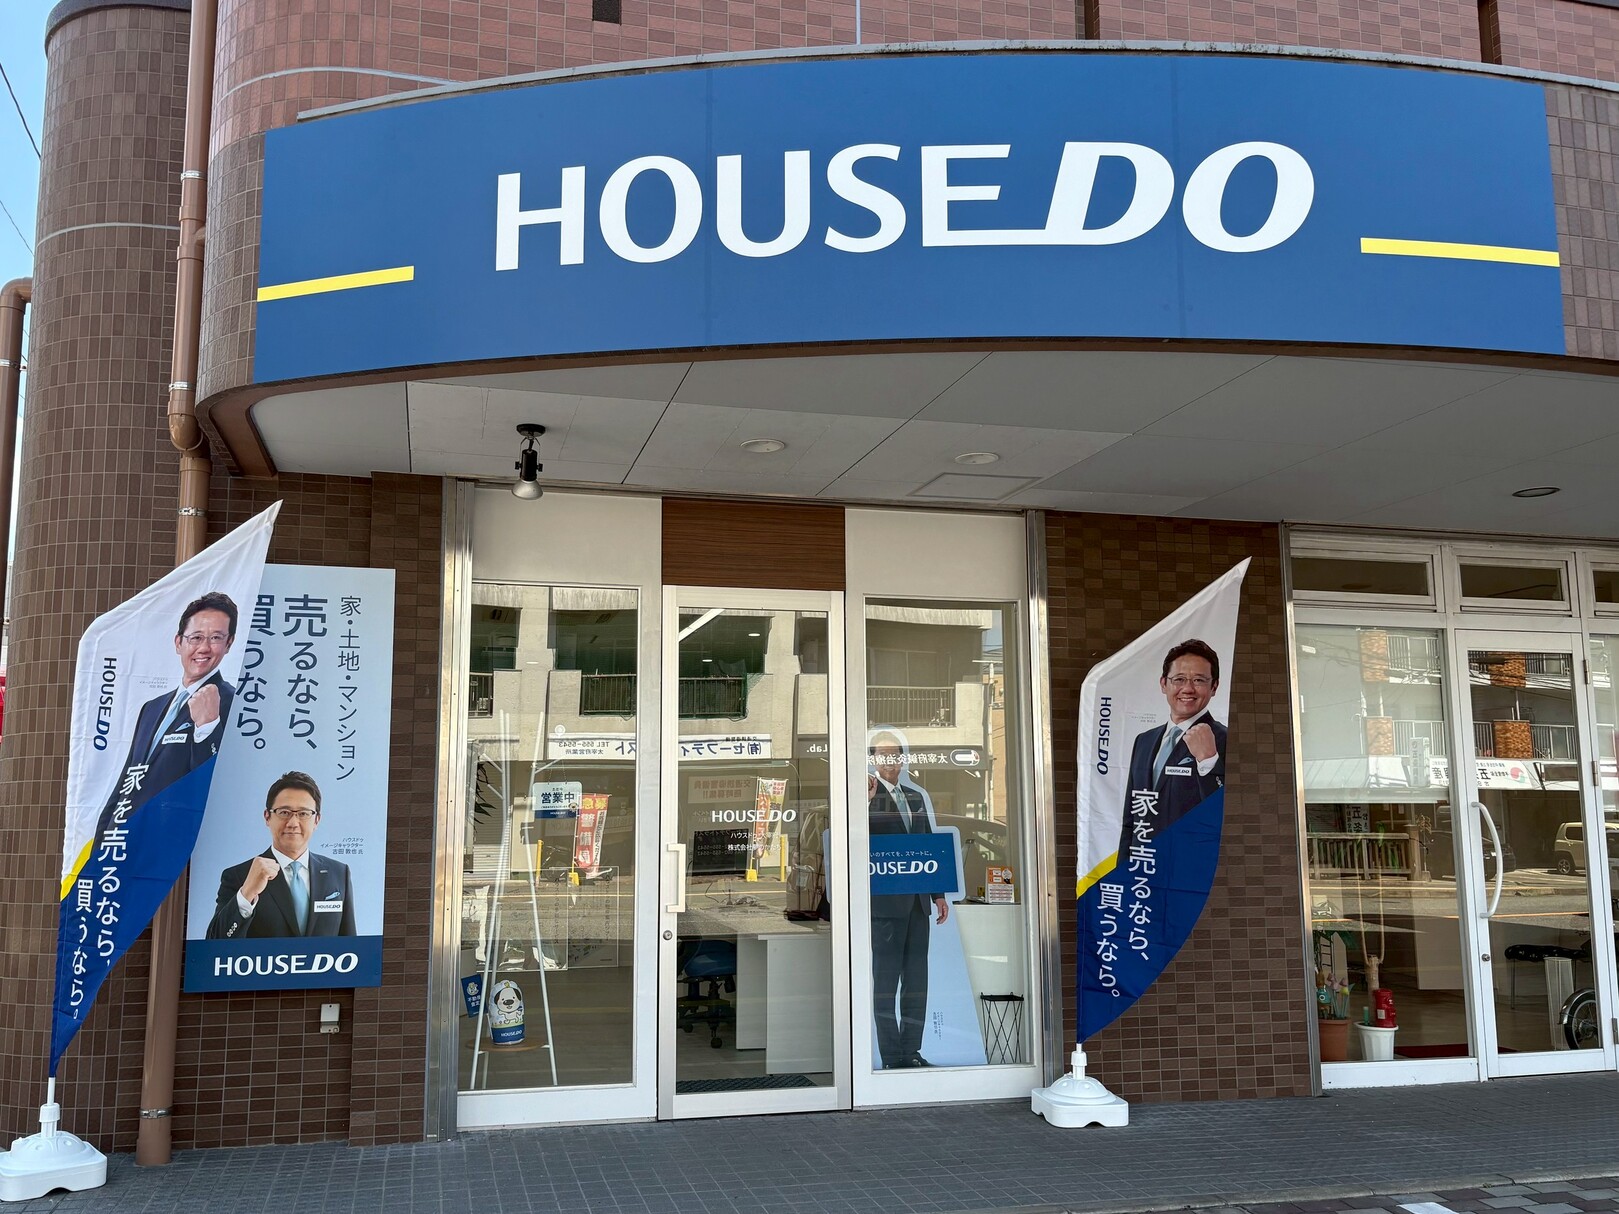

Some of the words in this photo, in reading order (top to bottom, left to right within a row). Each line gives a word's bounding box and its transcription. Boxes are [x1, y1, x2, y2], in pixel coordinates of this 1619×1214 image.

[282, 593, 329, 750] 売るなら、
[335, 595, 362, 782] 家・土地・マンション
[96, 763, 150, 968] 家を売るなら、
[541, 791, 575, 804] 営業中
[1127, 787, 1159, 962] 家を売るなら、
[69, 878, 94, 1020] 買うなら。
[1097, 882, 1125, 998] 買うなら。
